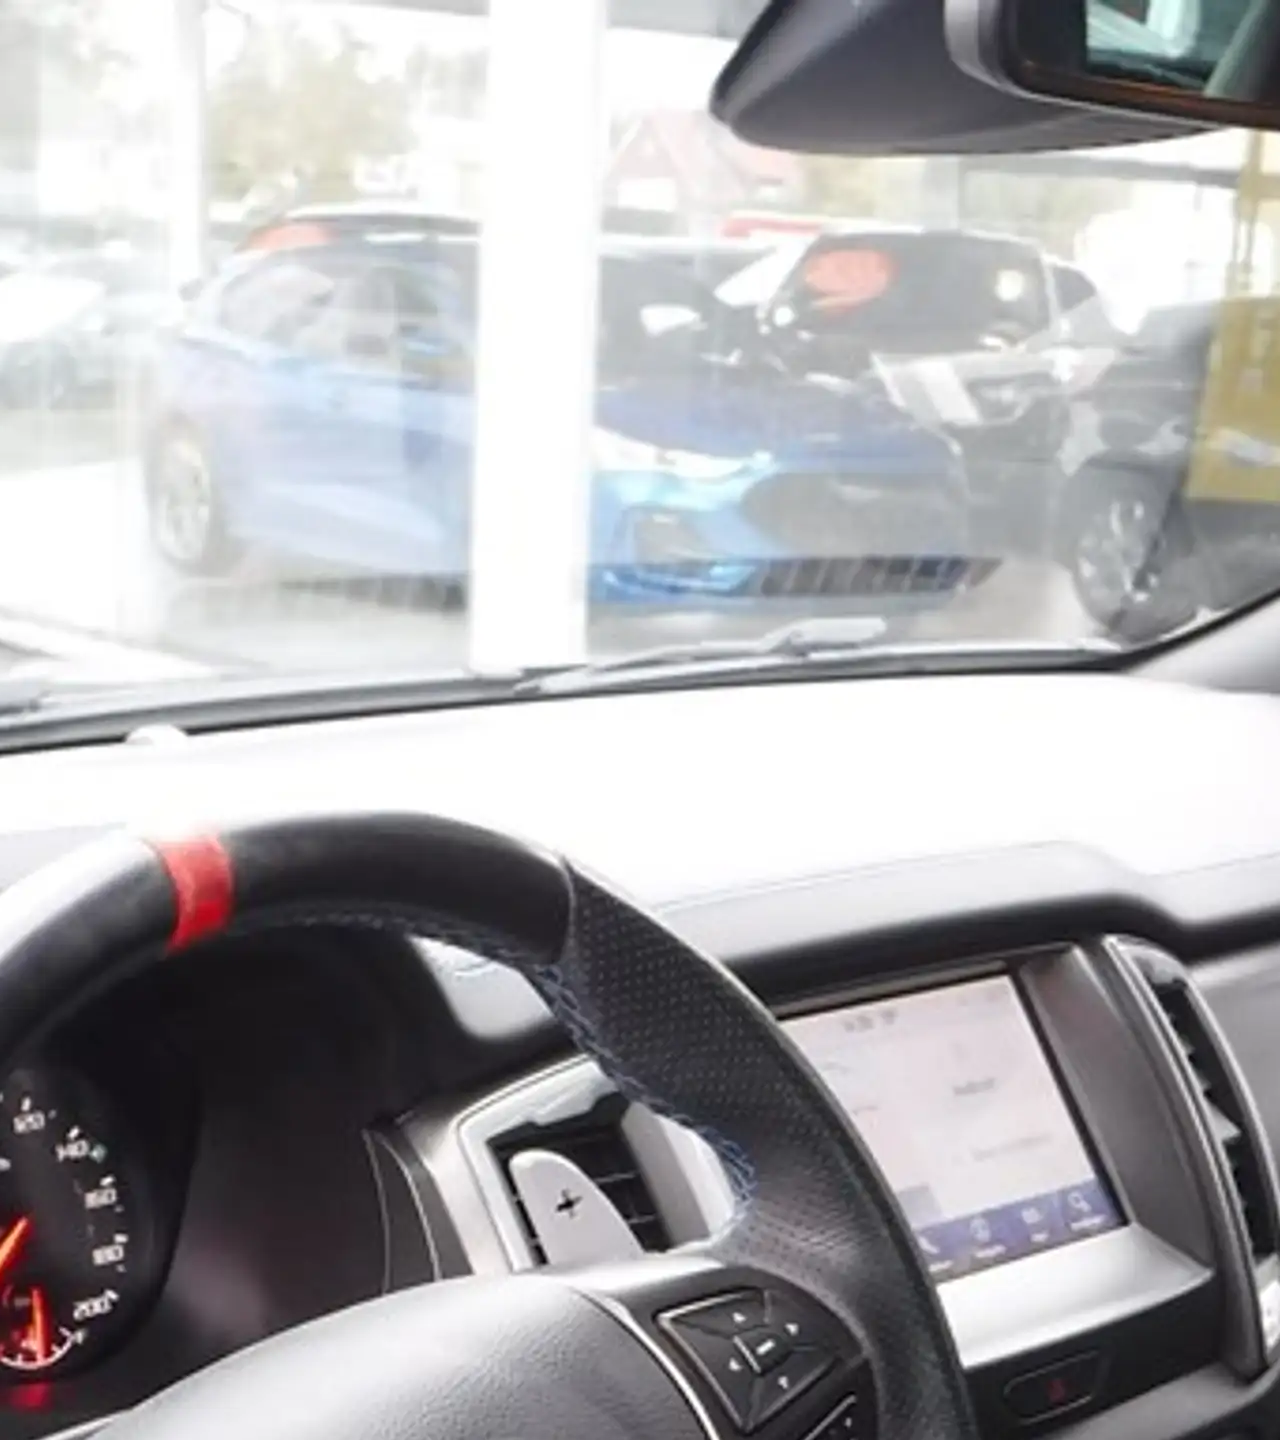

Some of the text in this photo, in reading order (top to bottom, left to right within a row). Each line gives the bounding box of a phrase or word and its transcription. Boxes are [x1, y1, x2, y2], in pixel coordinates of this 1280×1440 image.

[55, 1140, 90, 1161] 140
[85, 1189, 117, 1209] 160
[93, 1245, 124, 1266] 180
[72, 1298, 113, 1321] 200
